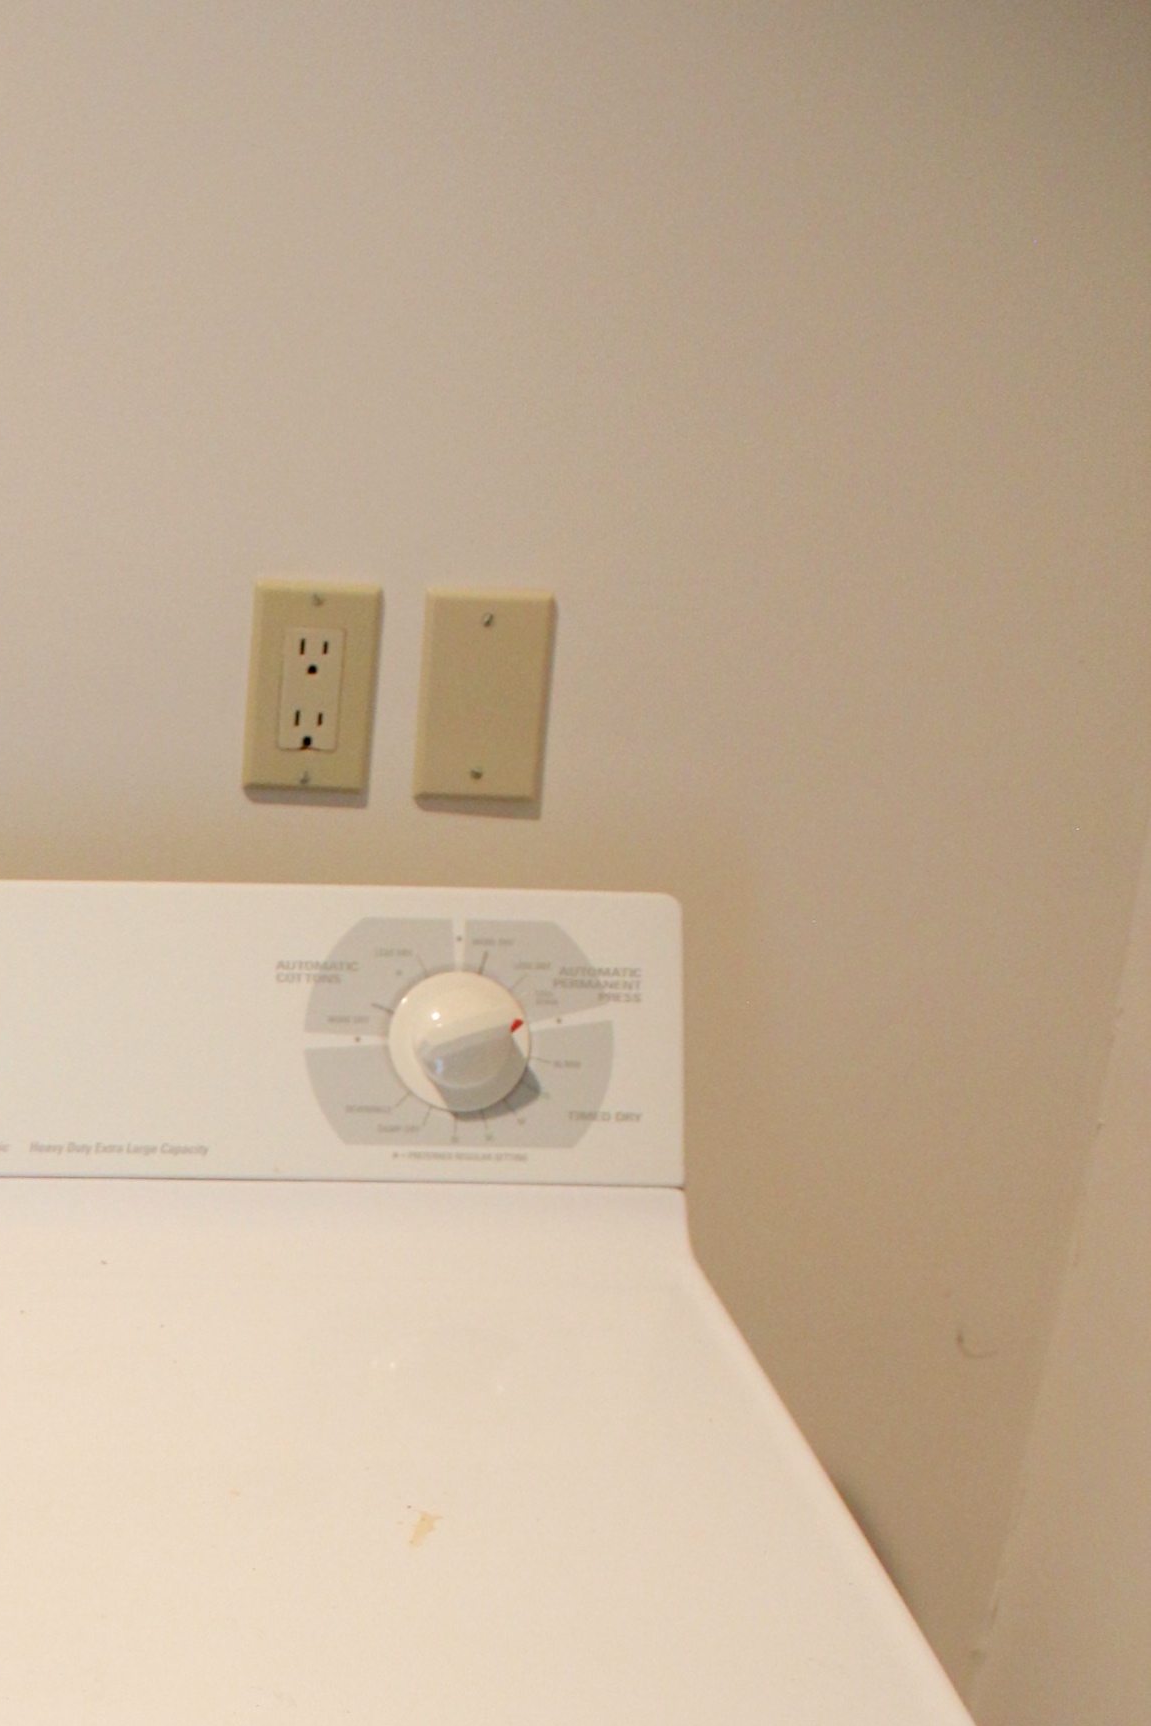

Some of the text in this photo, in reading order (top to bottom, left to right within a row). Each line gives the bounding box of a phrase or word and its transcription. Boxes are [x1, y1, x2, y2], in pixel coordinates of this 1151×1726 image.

[276, 960, 360, 972] AUTOMATIC
[558, 966, 642, 978] AUTOMATIC
[276, 972, 342, 984] COTTONS
[553, 978, 642, 990] PERMANENT
[597, 992, 643, 1003] PRESS
[569, 1111, 642, 1123] TIMED DRY
[29, 1141, 210, 1157] Heavy Duty Extra Large Capacity
